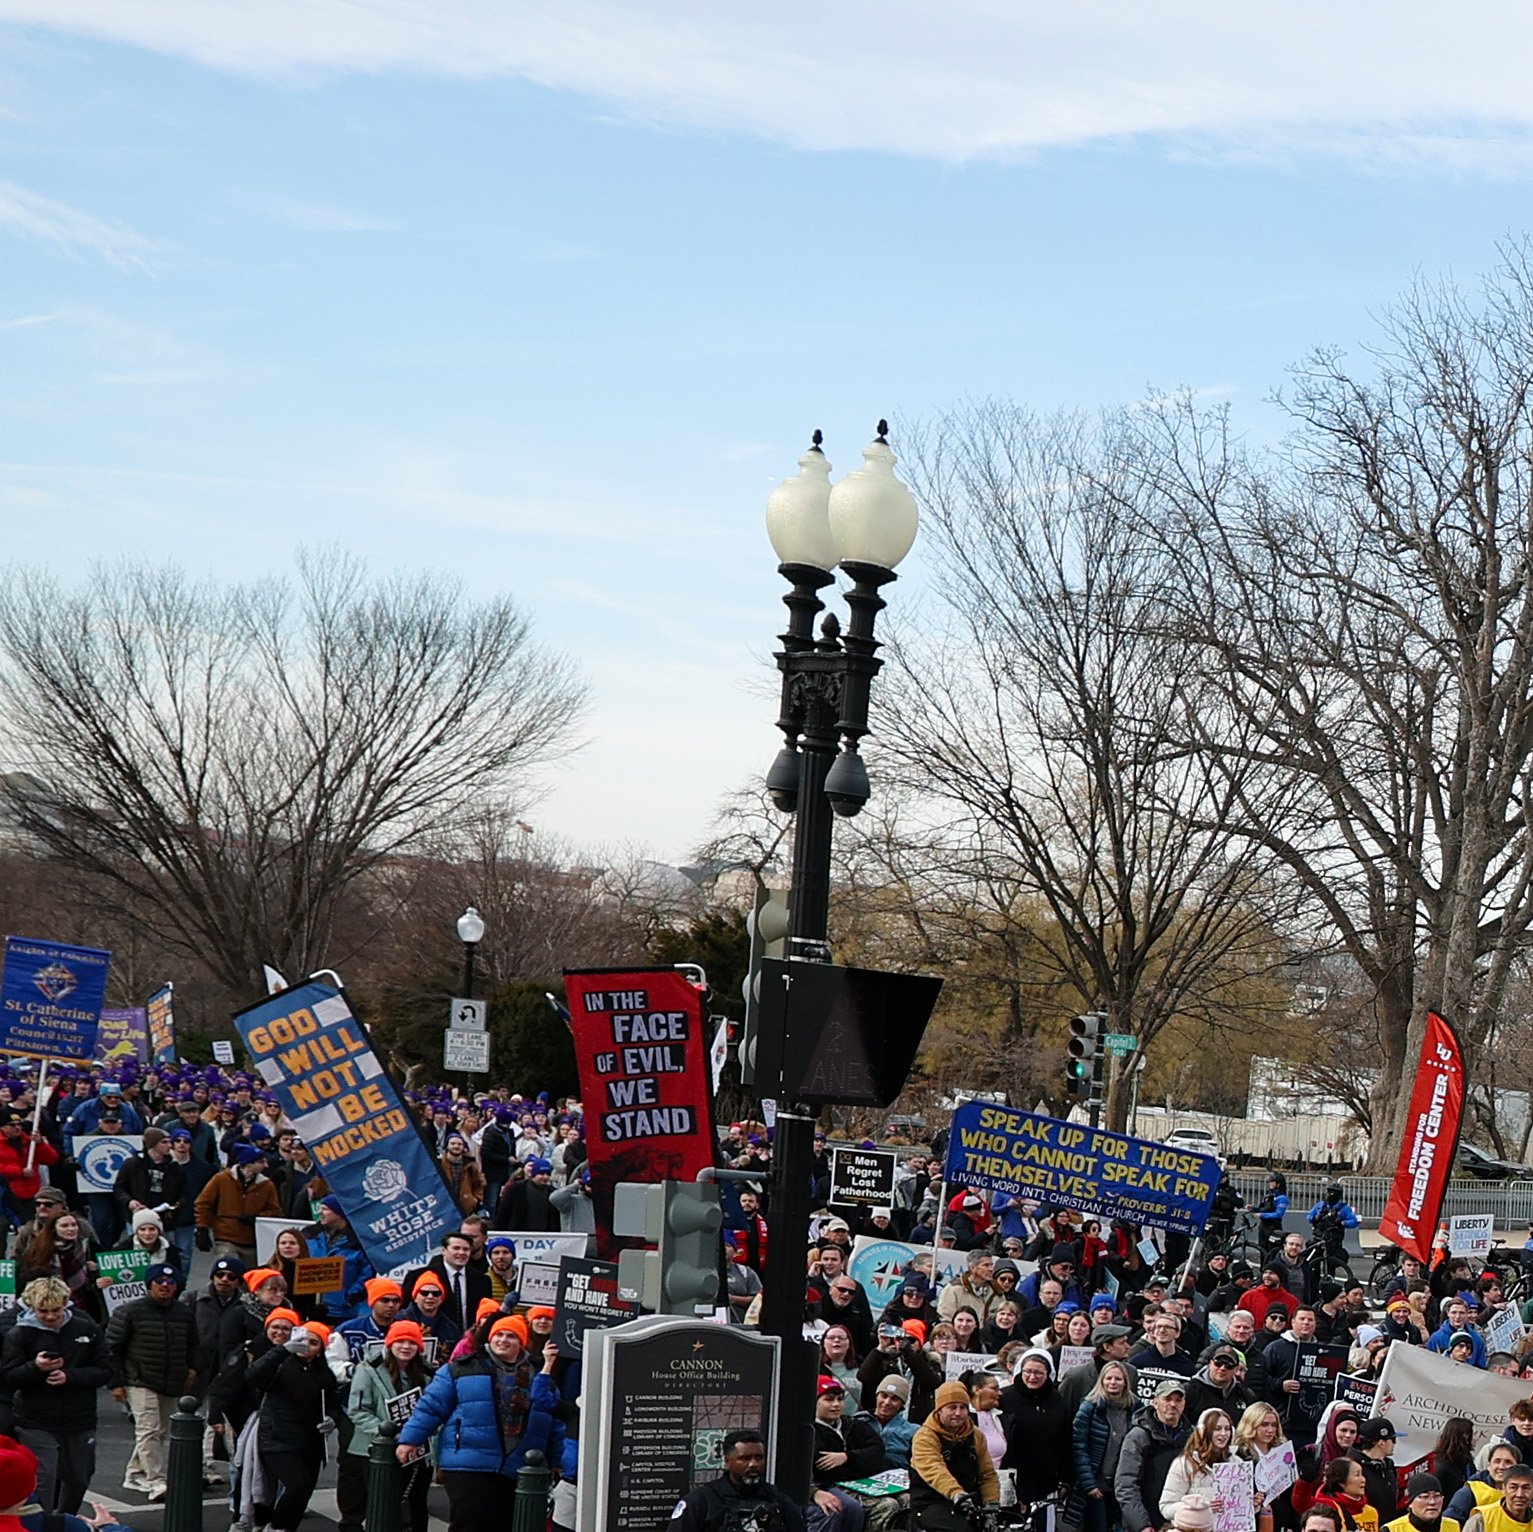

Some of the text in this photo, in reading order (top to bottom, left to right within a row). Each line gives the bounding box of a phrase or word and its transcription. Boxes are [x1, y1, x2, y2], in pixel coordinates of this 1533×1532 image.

[26, 1002, 95, 1021] Catherine
[585, 992, 645, 1011] IN THE
[10, 1026, 56, 1039] Council
[20, 1014, 77, 1031] of Siena
[248, 1008, 318, 1055] GOD
[613, 1013, 686, 1043] FACE
[278, 1027, 365, 1076] WILL
[596, 1047, 685, 1075] OF EVIL,
[288, 1060, 358, 1110] NOT
[609, 1078, 656, 1108] WE
[338, 1083, 389, 1124] BE
[606, 1108, 691, 1142] STAND
[313, 1108, 409, 1166] MOCKED
[979, 1108, 1204, 1178] SPEAK UP FOR THOSE
[1408, 1113, 1428, 1176] STANDING FOR
[1408, 1074, 1449, 1221] FREEDOM CENTER
[854, 1155, 878, 1167] Men
[960, 1128, 1210, 1201] WHO CANNOT SPEAK FOR
[846, 1166, 883, 1179] Regret
[852, 1176, 876, 1188] Lost
[833, 1185, 893, 1200] Fatherhood
[951, 1172, 1147, 1224] LIVING WORD CHRISTIAN CHURCH
[368, 1194, 438, 1235] WHITE
[1118, 1196, 1167, 1214] PROVERBS
[384, 1212, 436, 1243] ROSE
[1454, 1218, 1490, 1230] LIBERTY
[386, 1220, 445, 1254] RESISTANCE
[523, 1240, 557, 1251] DAY
[1453, 1239, 1488, 1250] FOR LIFE
[100, 1252, 149, 1272] LOVE LIFE
[109, 1284, 147, 1301] CHOOS
[565, 1288, 610, 1308] AND HAVE
[1491, 1306, 1516, 1331] LIBERTY
[1509, 1329, 1523, 1344] LIFE
[670, 1360, 724, 1370] CANNON
[1300, 1366, 1328, 1379] AND HAVE
[652, 1371, 741, 1381] House Office Building
[1344, 1389, 1374, 1404] PERSO
[1402, 1394, 1507, 1425] ARCHDIOCESE
